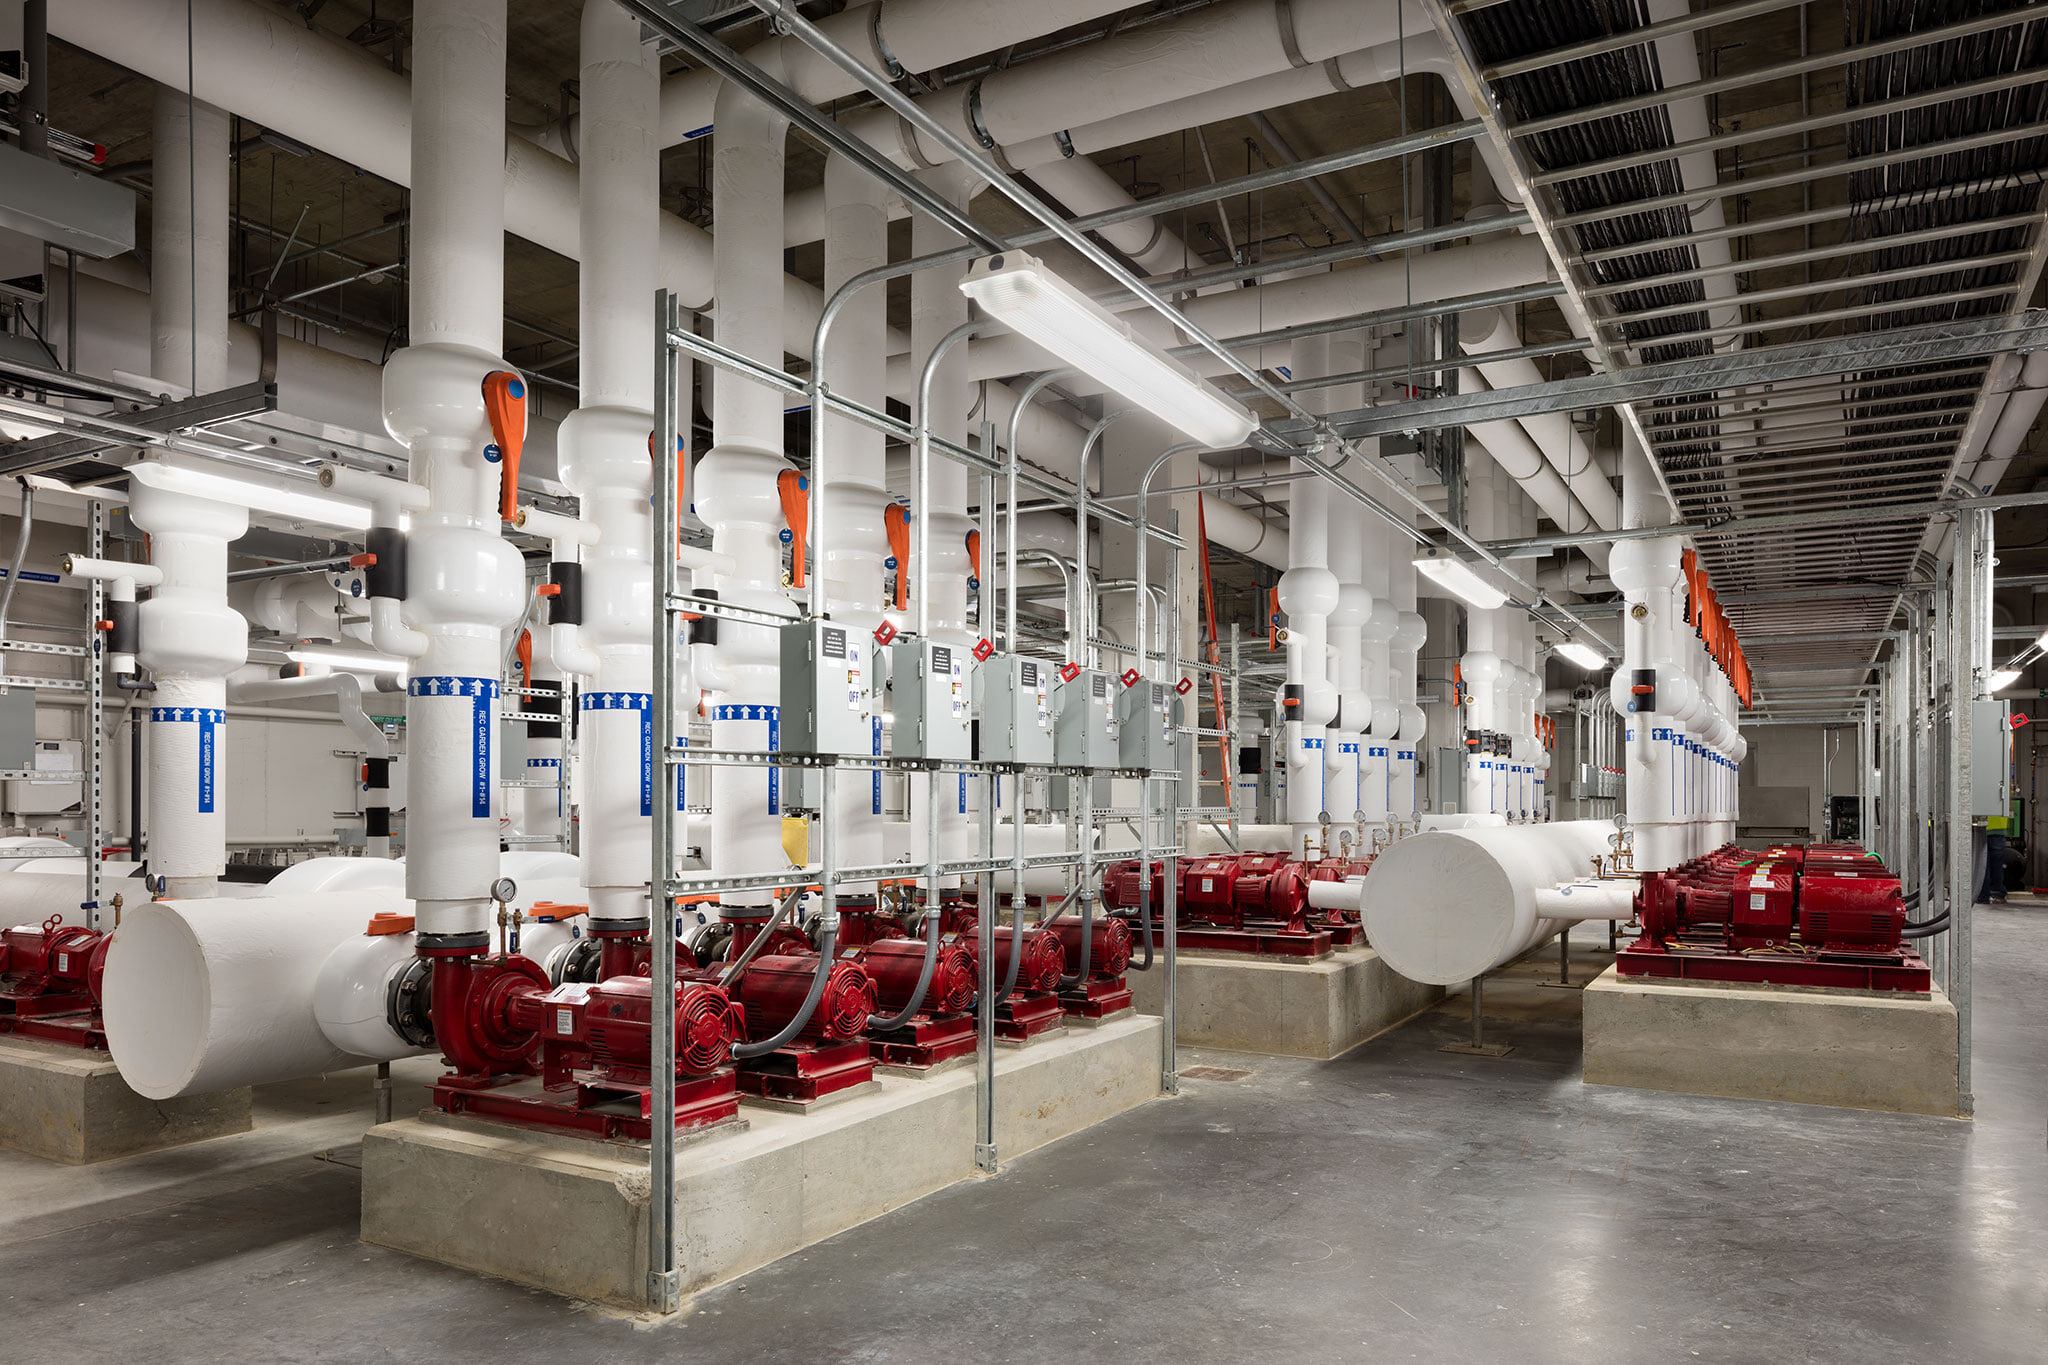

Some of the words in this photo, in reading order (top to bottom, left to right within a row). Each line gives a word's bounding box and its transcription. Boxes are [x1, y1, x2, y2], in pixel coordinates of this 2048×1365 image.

[850, 650, 858, 662] ON
[953, 664, 961, 675] ON
[849, 690, 859, 703] OFF
[478, 710, 486, 724] REC
[203, 731, 211, 743] REC
[478, 727, 486, 755] GARDEN
[203, 744, 211, 766] GARDEN
[203, 767, 211, 784] GROW
[478, 758, 486, 779] GROW
[478, 782, 486, 805] #1-#14
